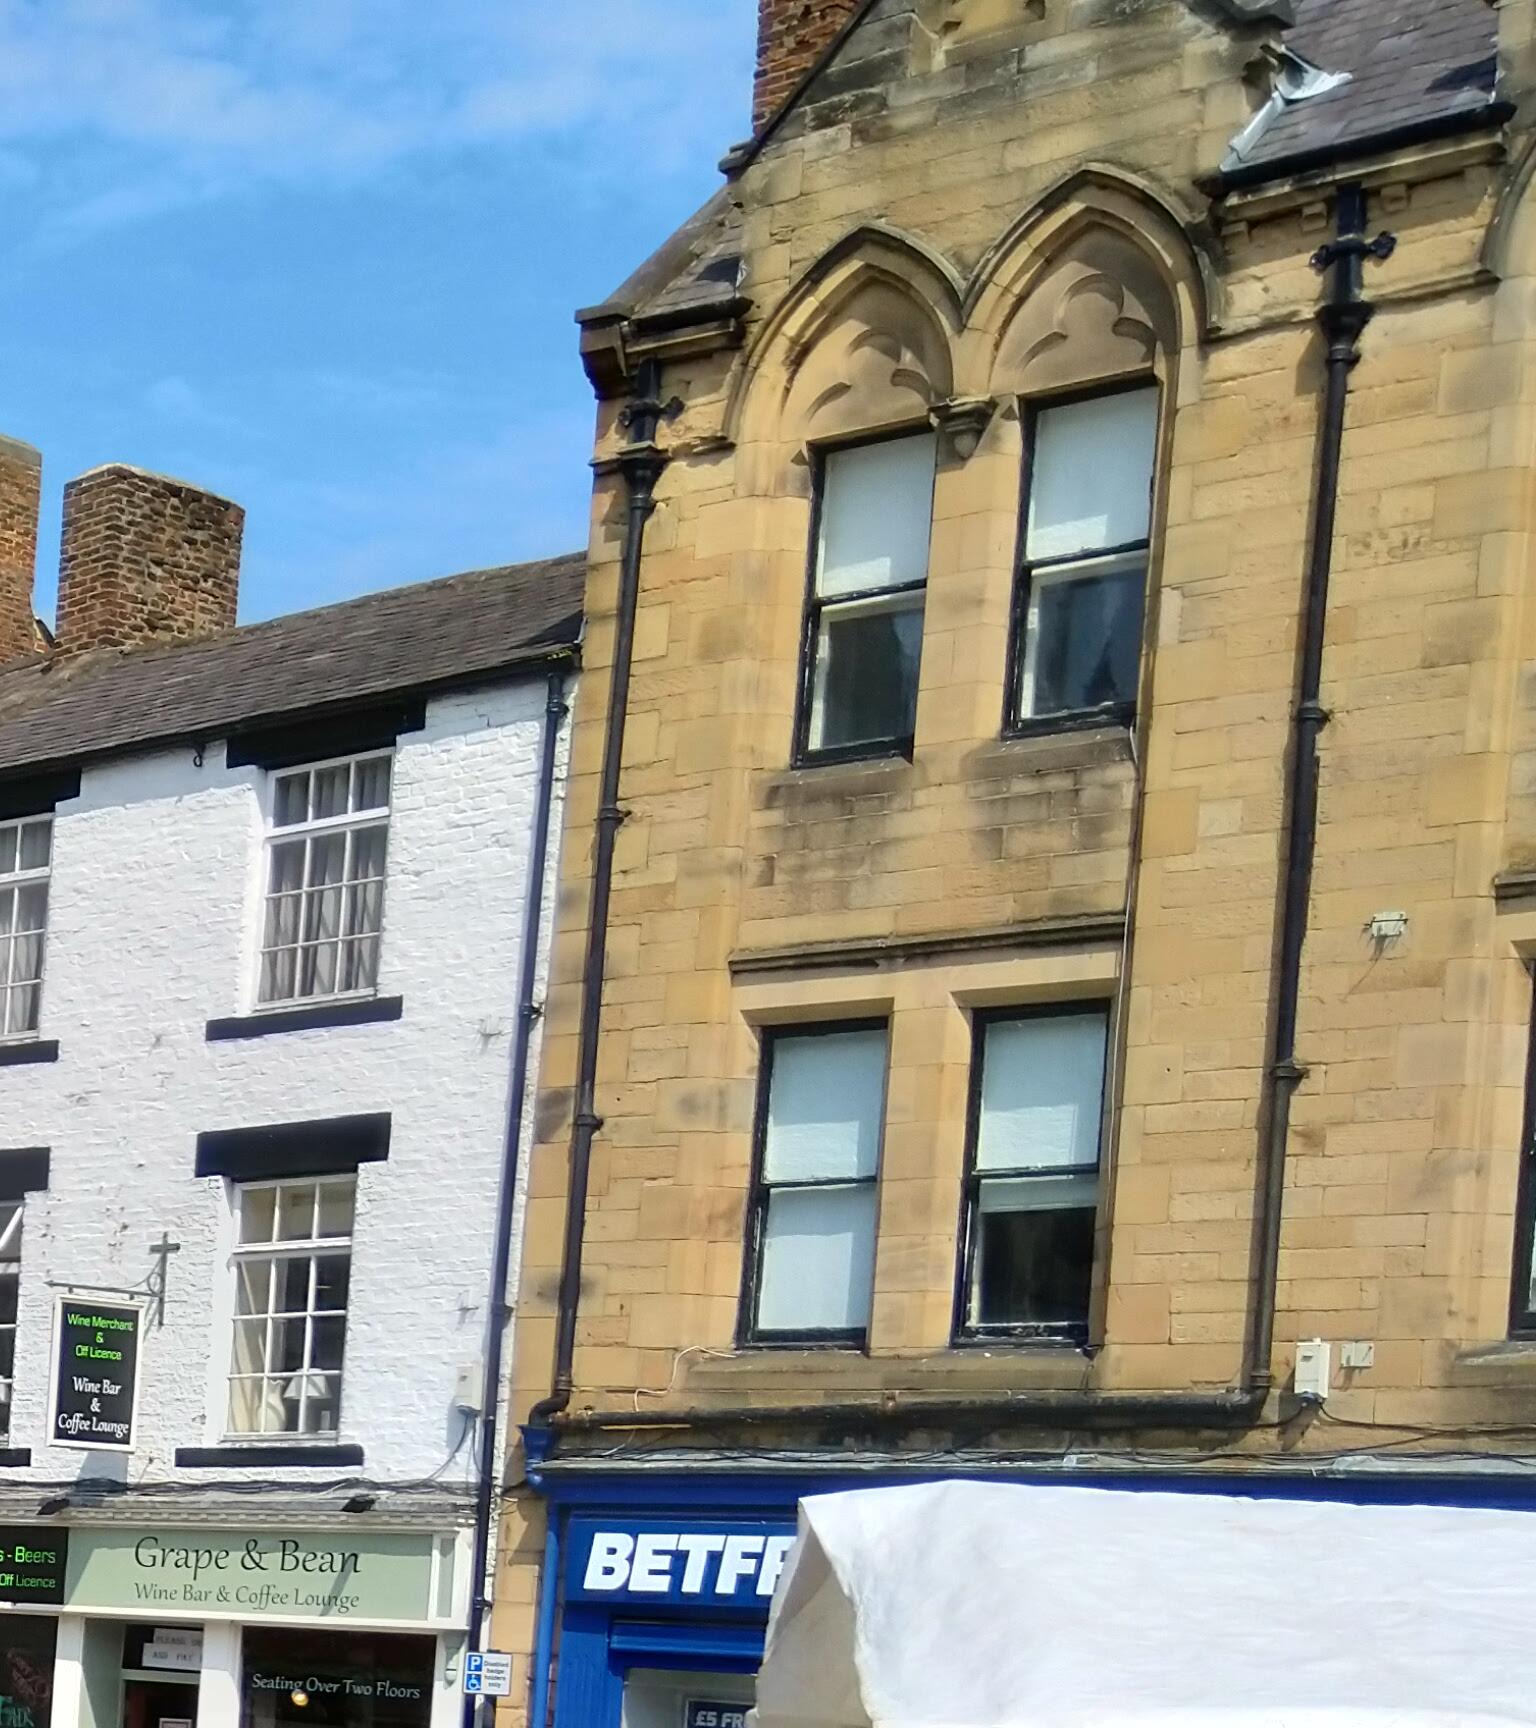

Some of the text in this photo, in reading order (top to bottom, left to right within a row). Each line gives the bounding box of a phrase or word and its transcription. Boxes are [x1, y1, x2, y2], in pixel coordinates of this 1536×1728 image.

[67, 1313, 134, 1331] Wine Merchant
[96, 1332, 104, 1343] &
[75, 1344, 122, 1361] Off Licence
[72, 1376, 122, 1395] Wine Bar
[90, 1397, 101, 1413] &
[58, 1413, 129, 1439] Coffee Lounge
[15, 1546, 56, 1564] Beers
[134, 1536, 361, 1581] Grape & Bean
[15, 1574, 56, 1588] Licence
[134, 1583, 360, 1614] Wine Bar & Coffee Lounge
[252, 1673, 421, 1699] Seating Over Two Floors
[695, 1711, 746, 1728] £5 FR
